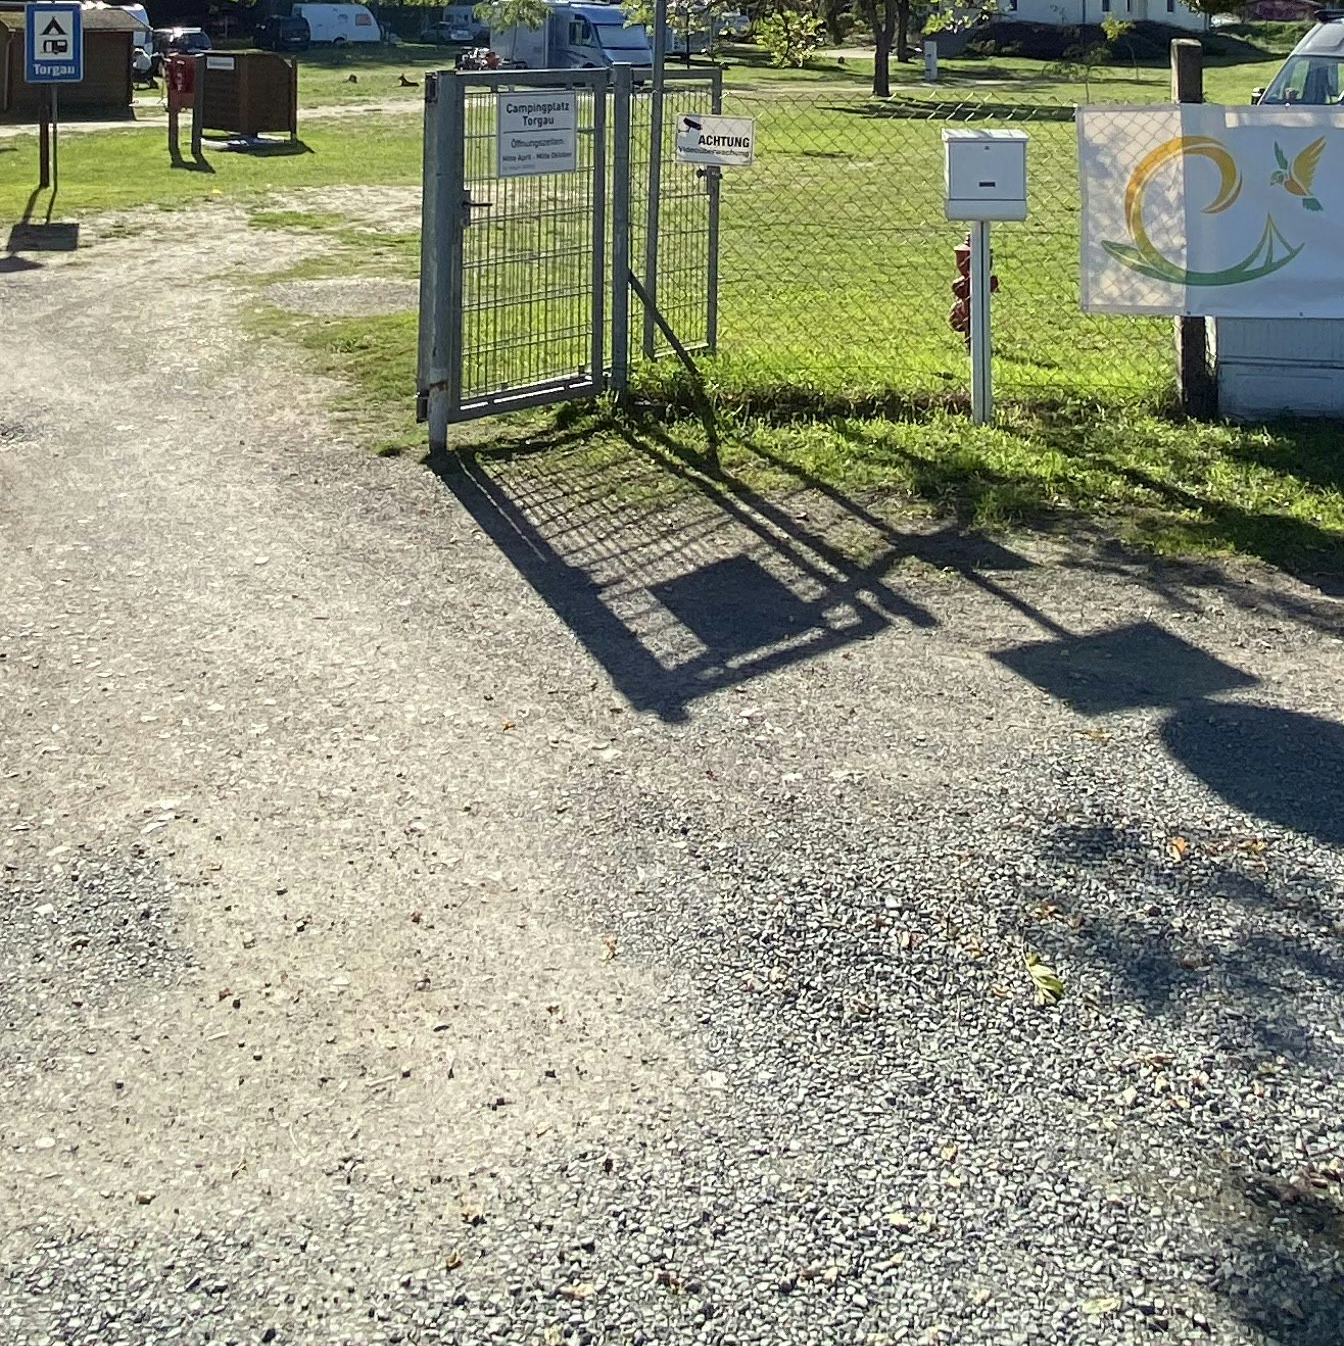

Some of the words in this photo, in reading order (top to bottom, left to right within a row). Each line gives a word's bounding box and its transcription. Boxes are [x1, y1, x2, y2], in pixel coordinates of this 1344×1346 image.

[33, 63, 75, 76] Torgau
[506, 102, 570, 115] Campingplatz
[523, 116, 554, 128] Torgau
[698, 135, 750, 148] ACHTUNG
